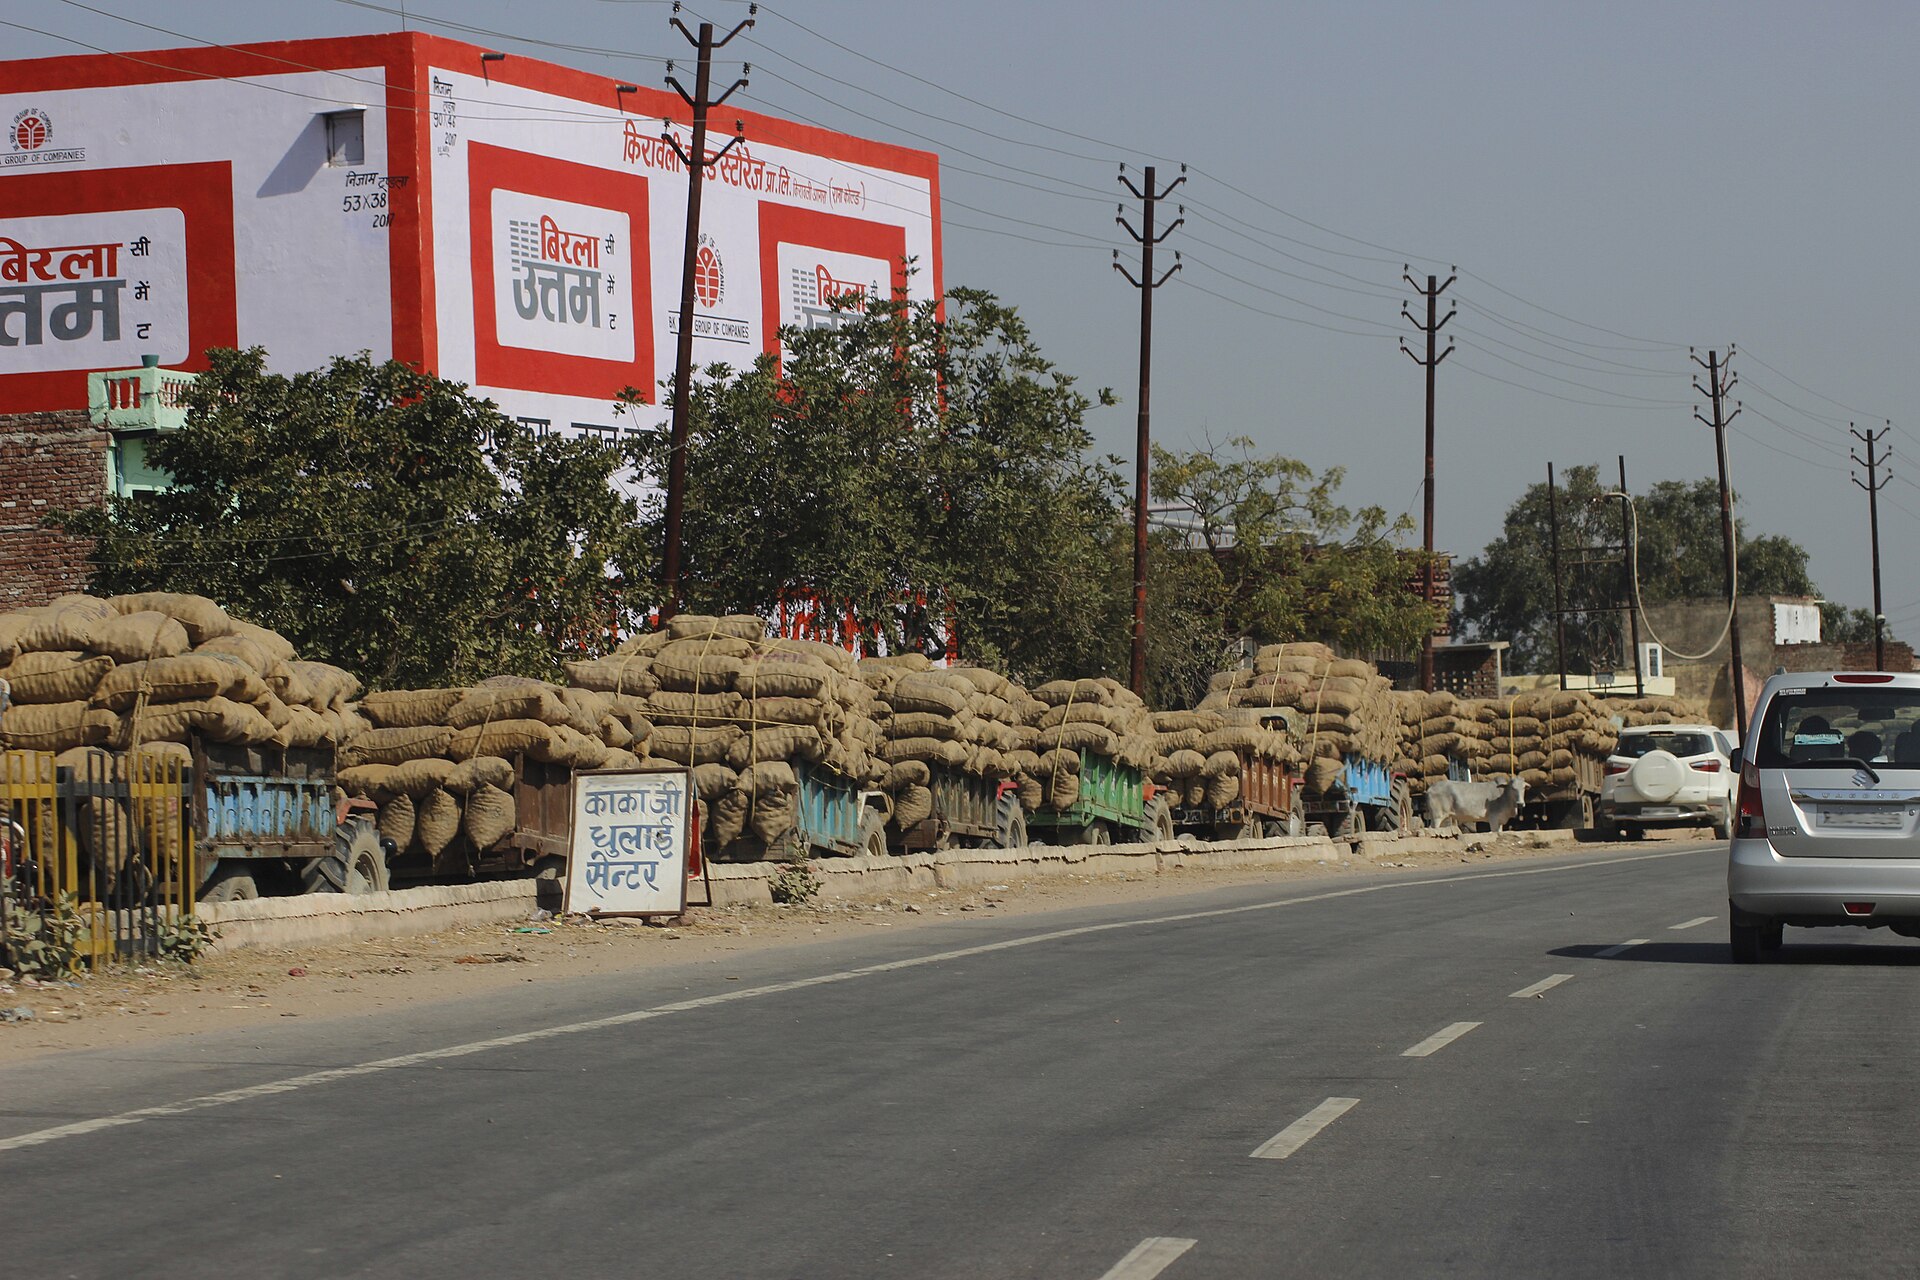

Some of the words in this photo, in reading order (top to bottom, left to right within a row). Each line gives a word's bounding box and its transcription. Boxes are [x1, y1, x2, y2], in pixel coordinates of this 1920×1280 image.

[4, 154, 29, 165] GROUP
[31, 153, 40, 162] OF
[43, 150, 86, 162] COMPANIES
[345, 171, 379, 187] निजाम
[372, 213, 395, 228] 2017
[540, 214, 600, 269] बिरला
[512, 260, 602, 328] उत्तम
[694, 319, 712, 335] GROUP
[713, 322, 720, 334] OF
[721, 324, 749, 339] COMPANIES
